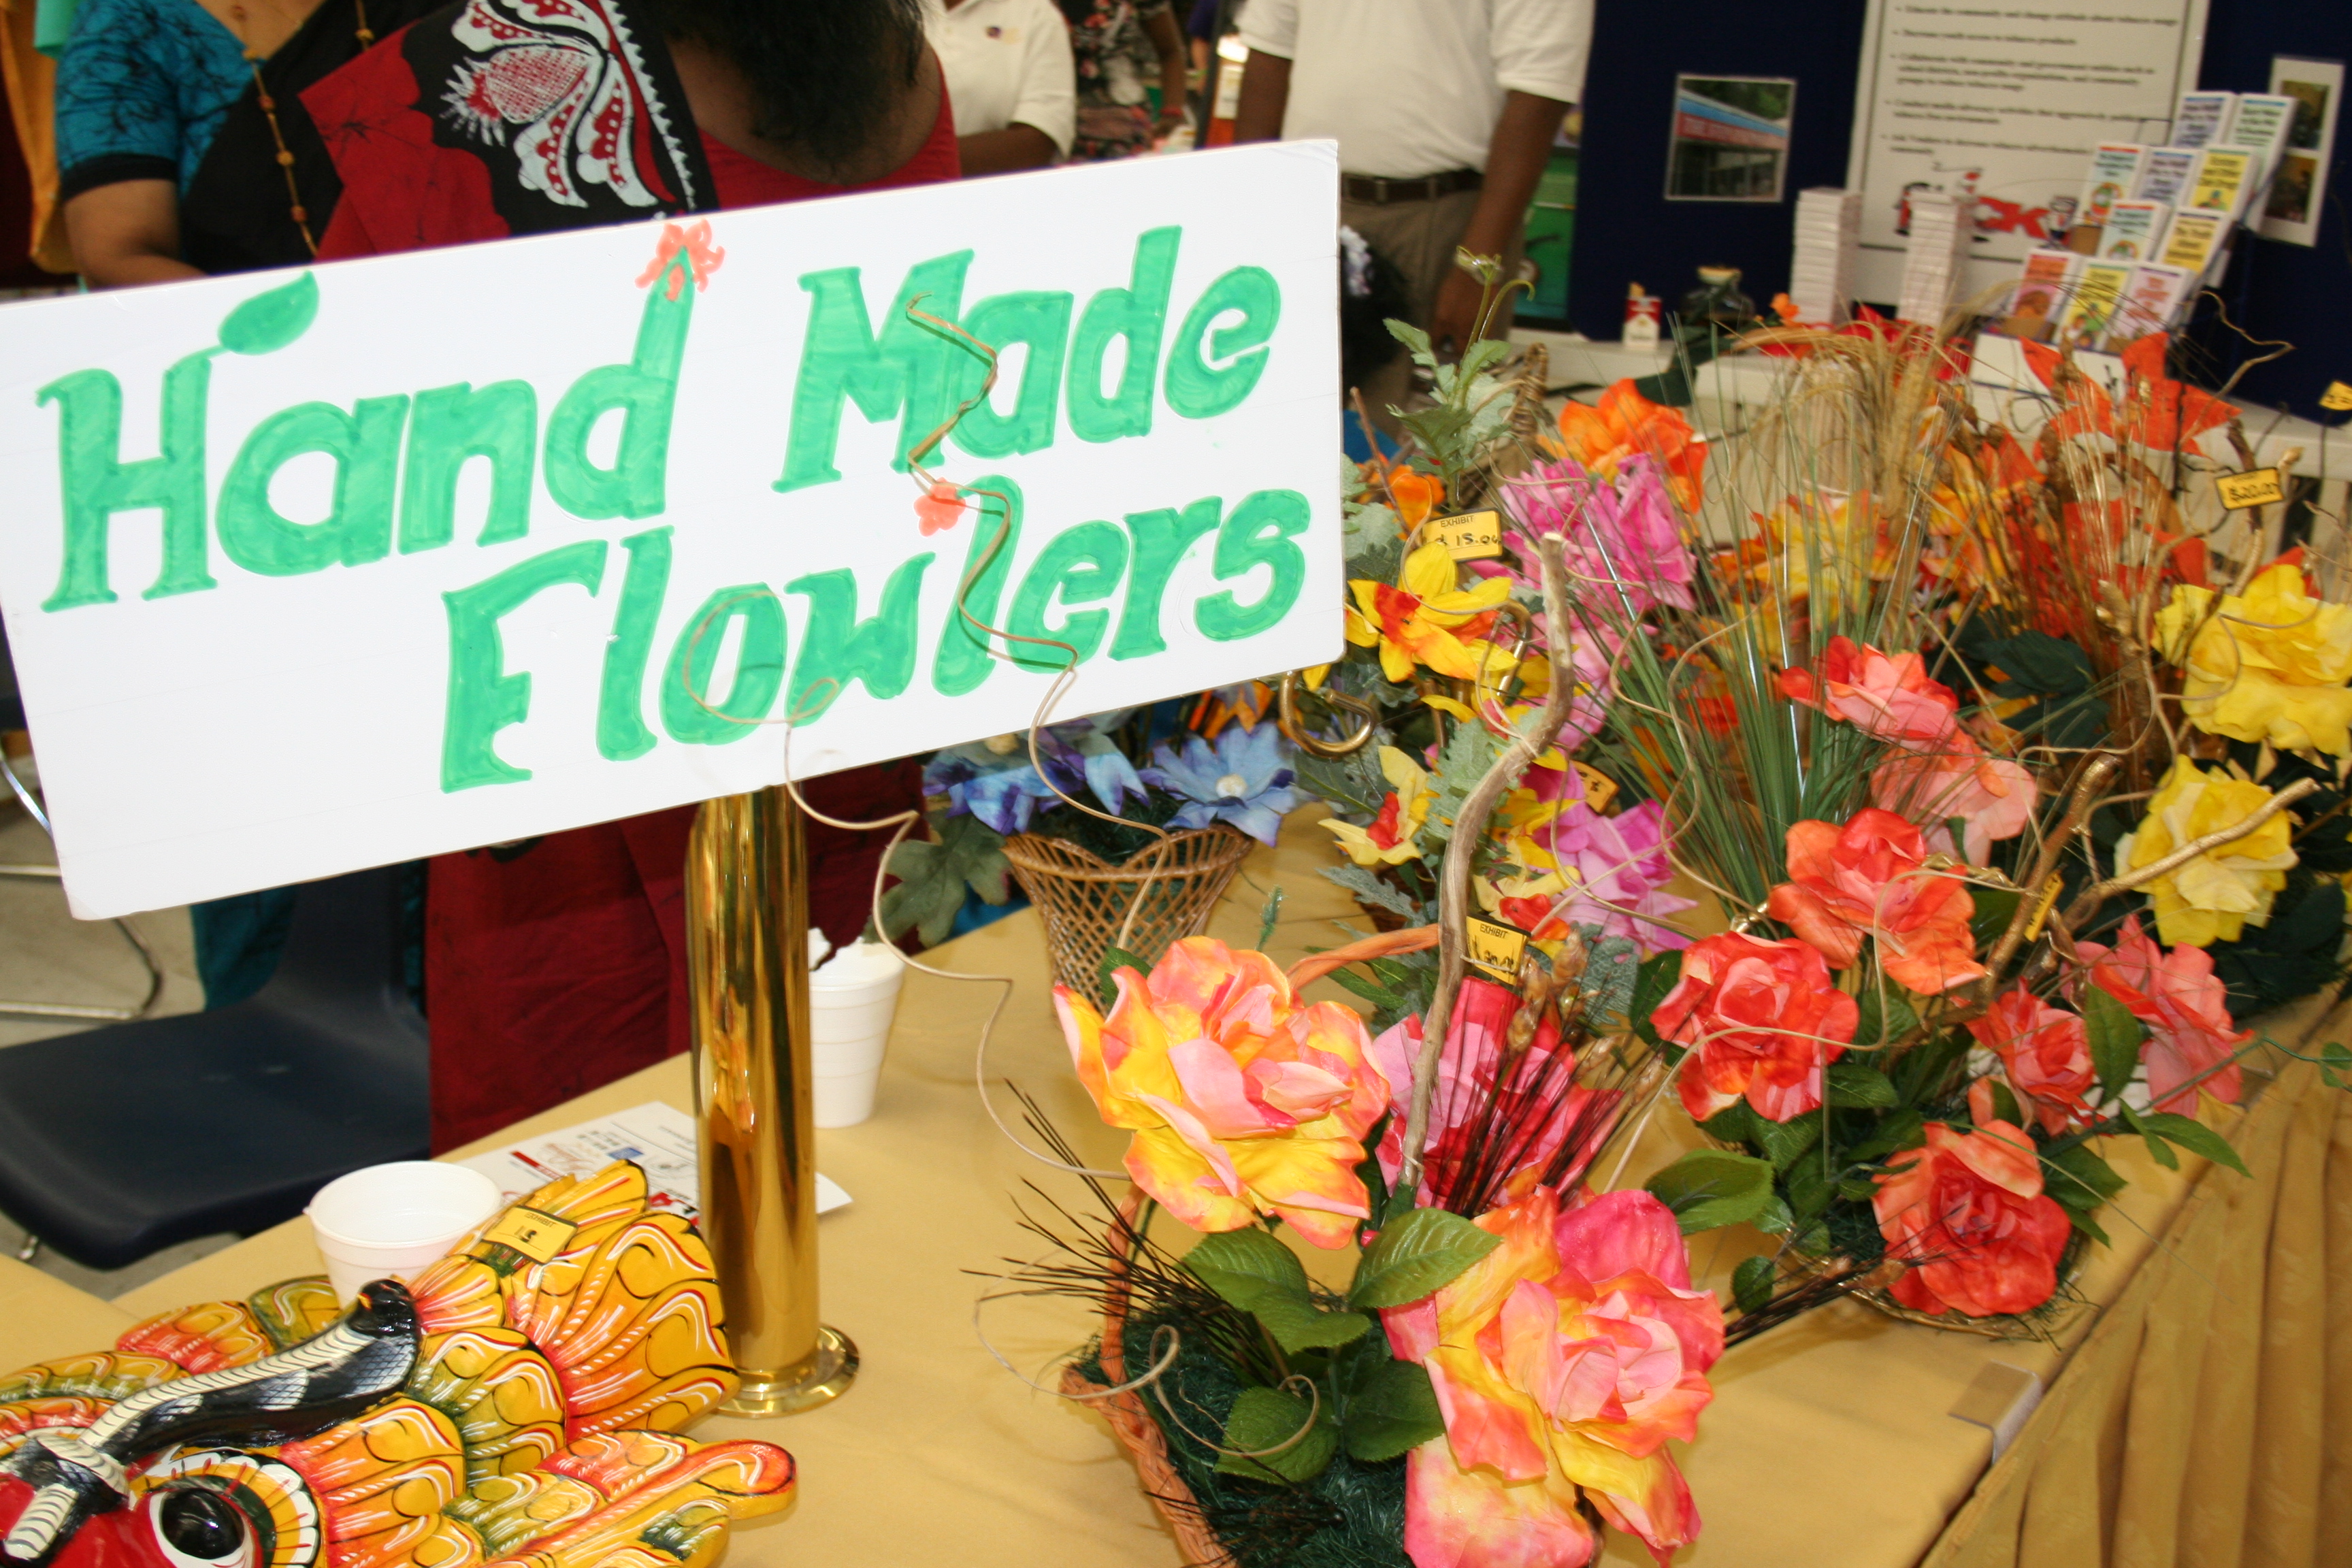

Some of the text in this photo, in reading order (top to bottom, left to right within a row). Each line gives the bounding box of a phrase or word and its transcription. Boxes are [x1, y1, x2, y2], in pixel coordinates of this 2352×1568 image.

[35, 225, 1282, 614] Hand Made
[1440, 514, 1475, 528] EXHIBIT
[1480, 923, 1509, 939] EXHIBIT
[524, 1211, 557, 1228] EXHIBIT
